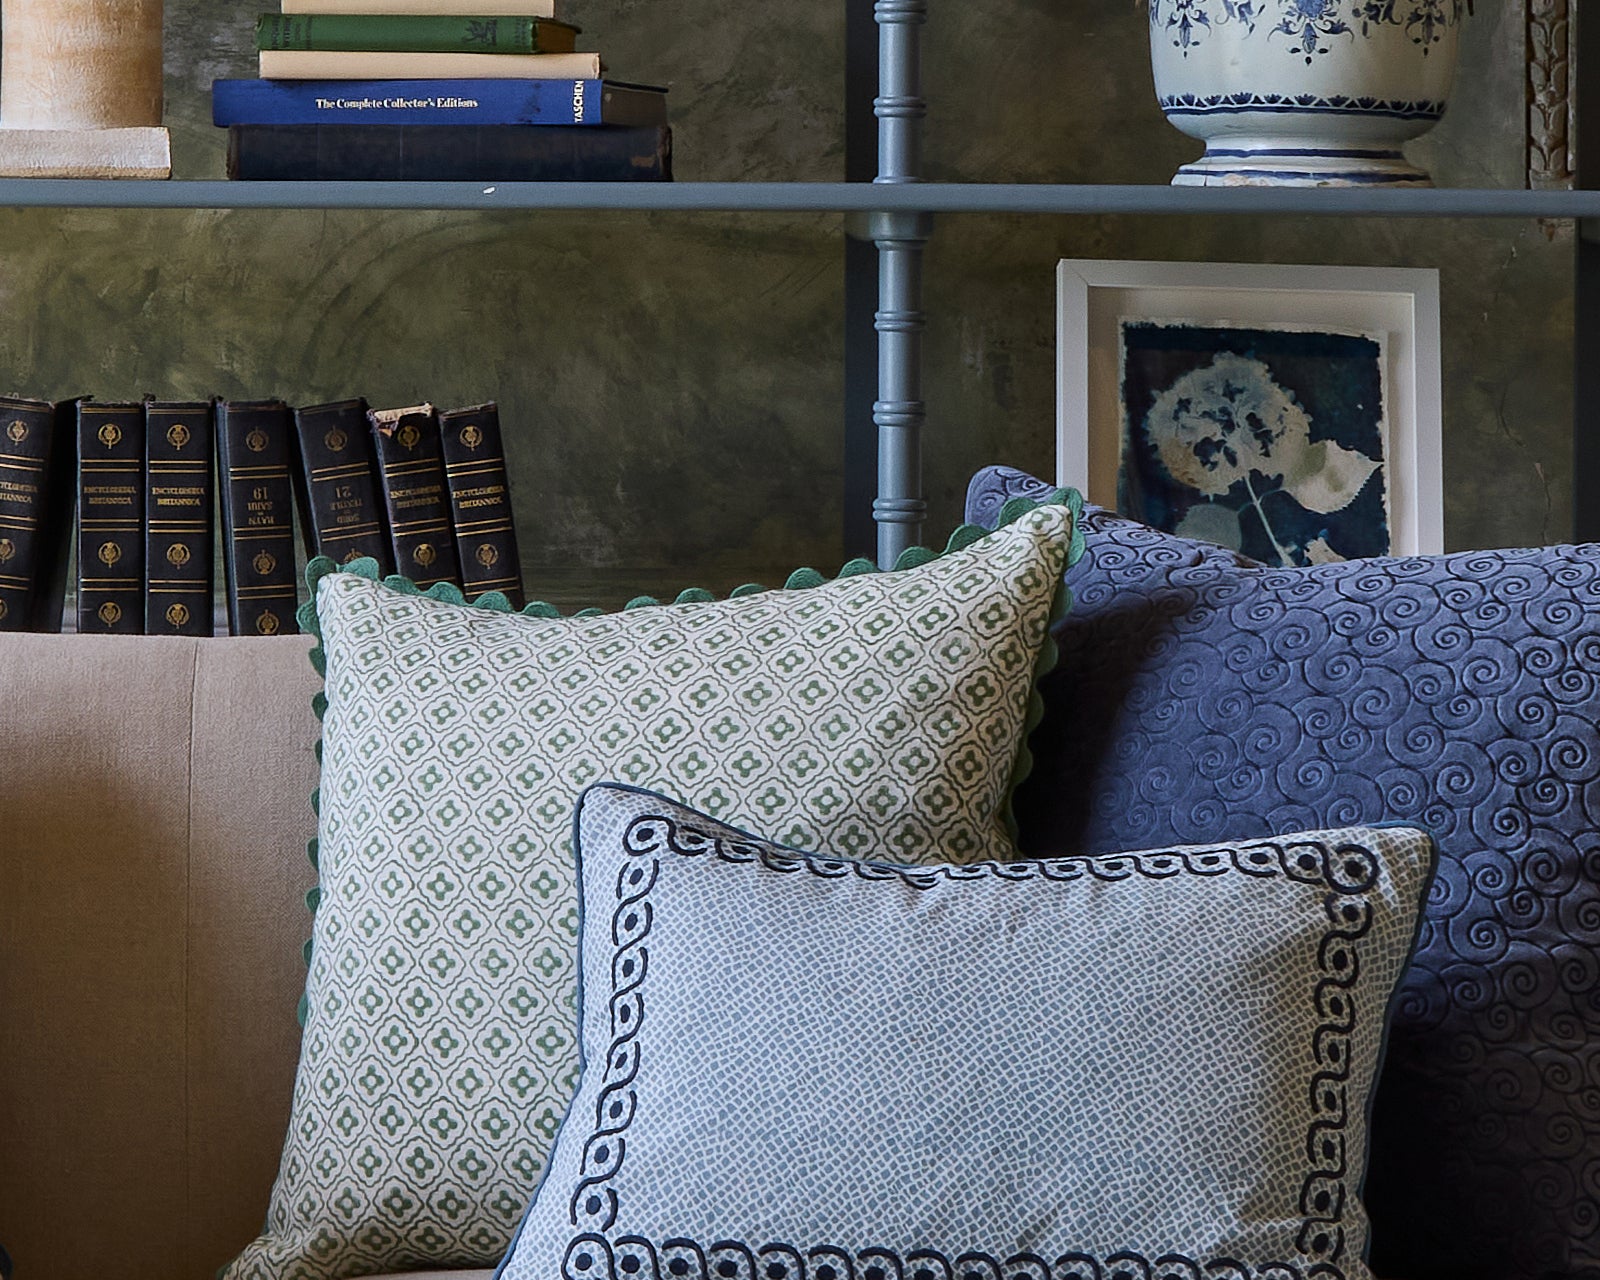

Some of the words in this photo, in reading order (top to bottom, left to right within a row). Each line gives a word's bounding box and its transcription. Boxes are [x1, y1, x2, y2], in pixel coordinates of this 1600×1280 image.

[315, 98, 336, 109] The
[336, 98, 382, 111] Complete
[383, 97, 435, 109] Collector's
[436, 97, 479, 109] Editions
[573, 80, 584, 123] TASCHEN
[253, 487, 269, 500] 19
[335, 486, 352, 498] 21
